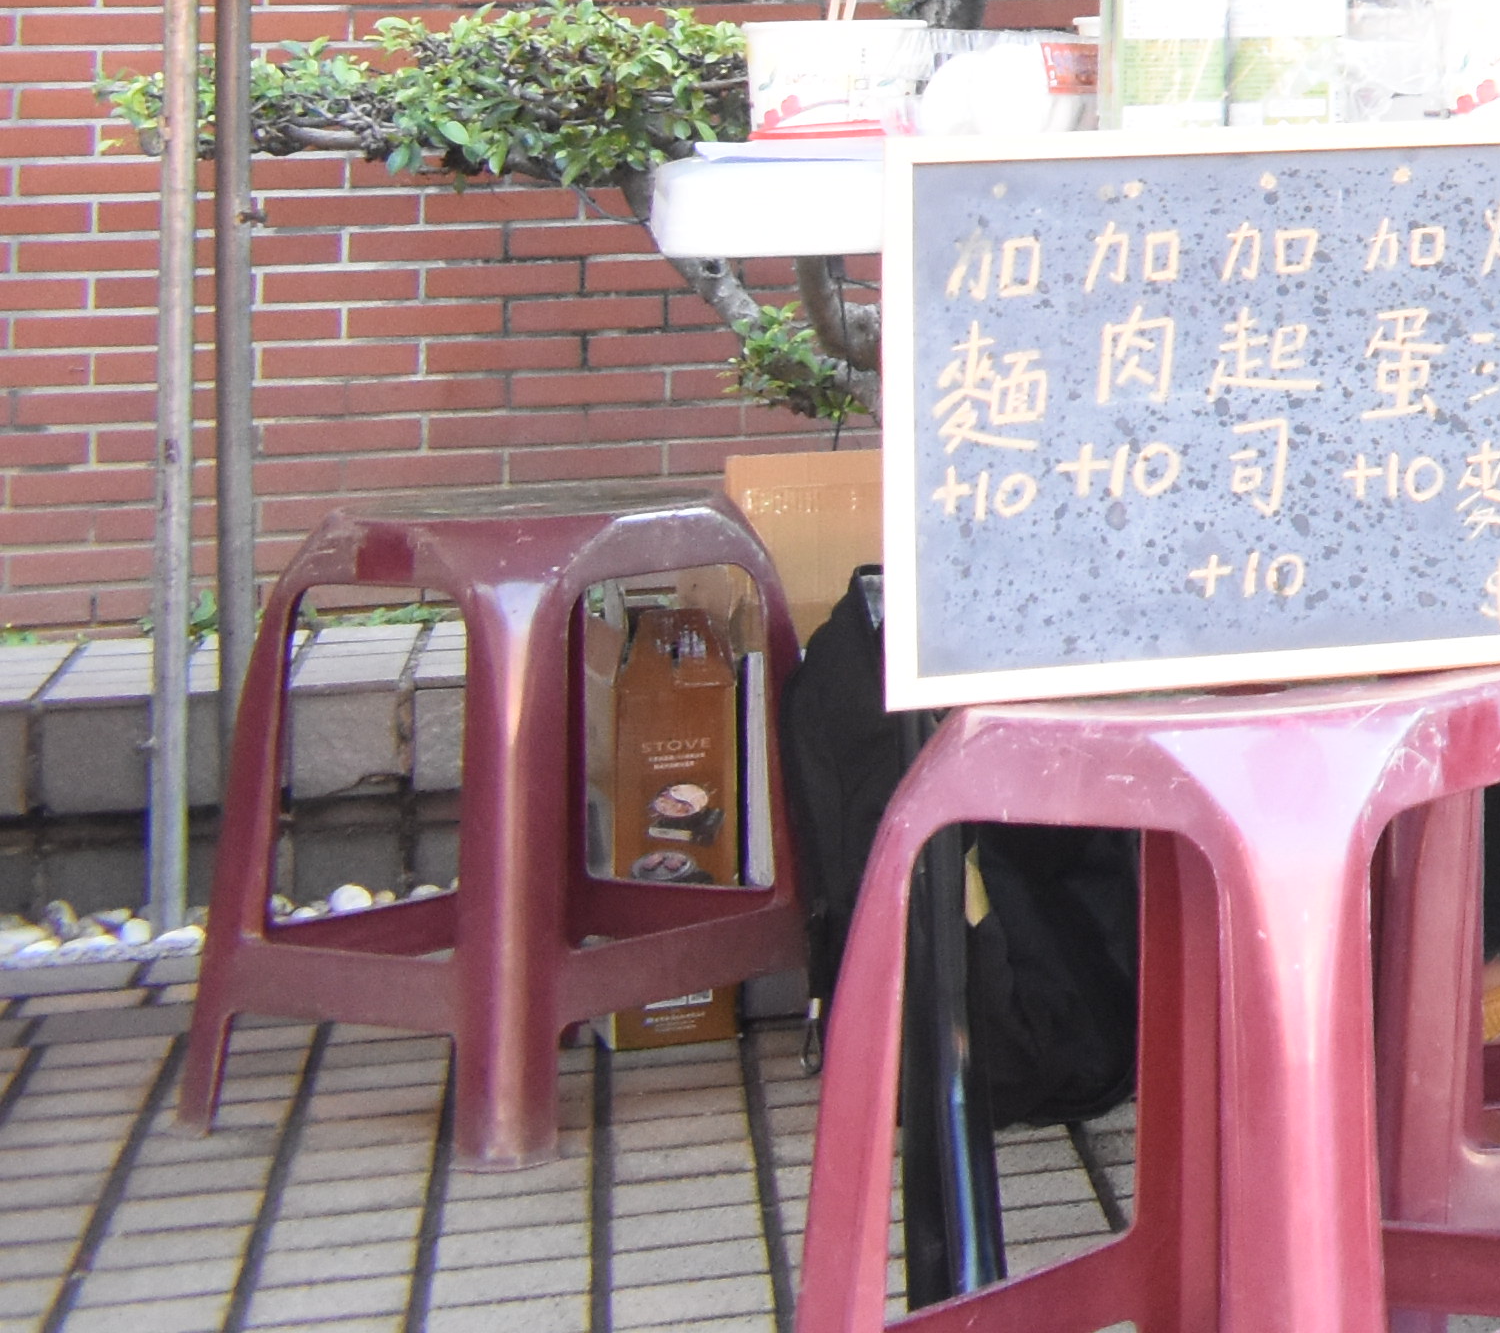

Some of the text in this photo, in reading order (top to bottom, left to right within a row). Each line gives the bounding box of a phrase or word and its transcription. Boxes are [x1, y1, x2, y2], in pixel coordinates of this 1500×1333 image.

[931, 230, 1048, 453] 加麵
[1082, 220, 1180, 404] 加肉
[1363, 218, 1445, 420] 加蛋
[1206, 220, 1321, 517] 加起司
[932, 465, 1039, 521] +10
[1056, 440, 1180, 500] +10
[1342, 454, 1444, 503] +10
[1188, 552, 1305, 599] +10
[641, 737, 713, 754] STOVE
